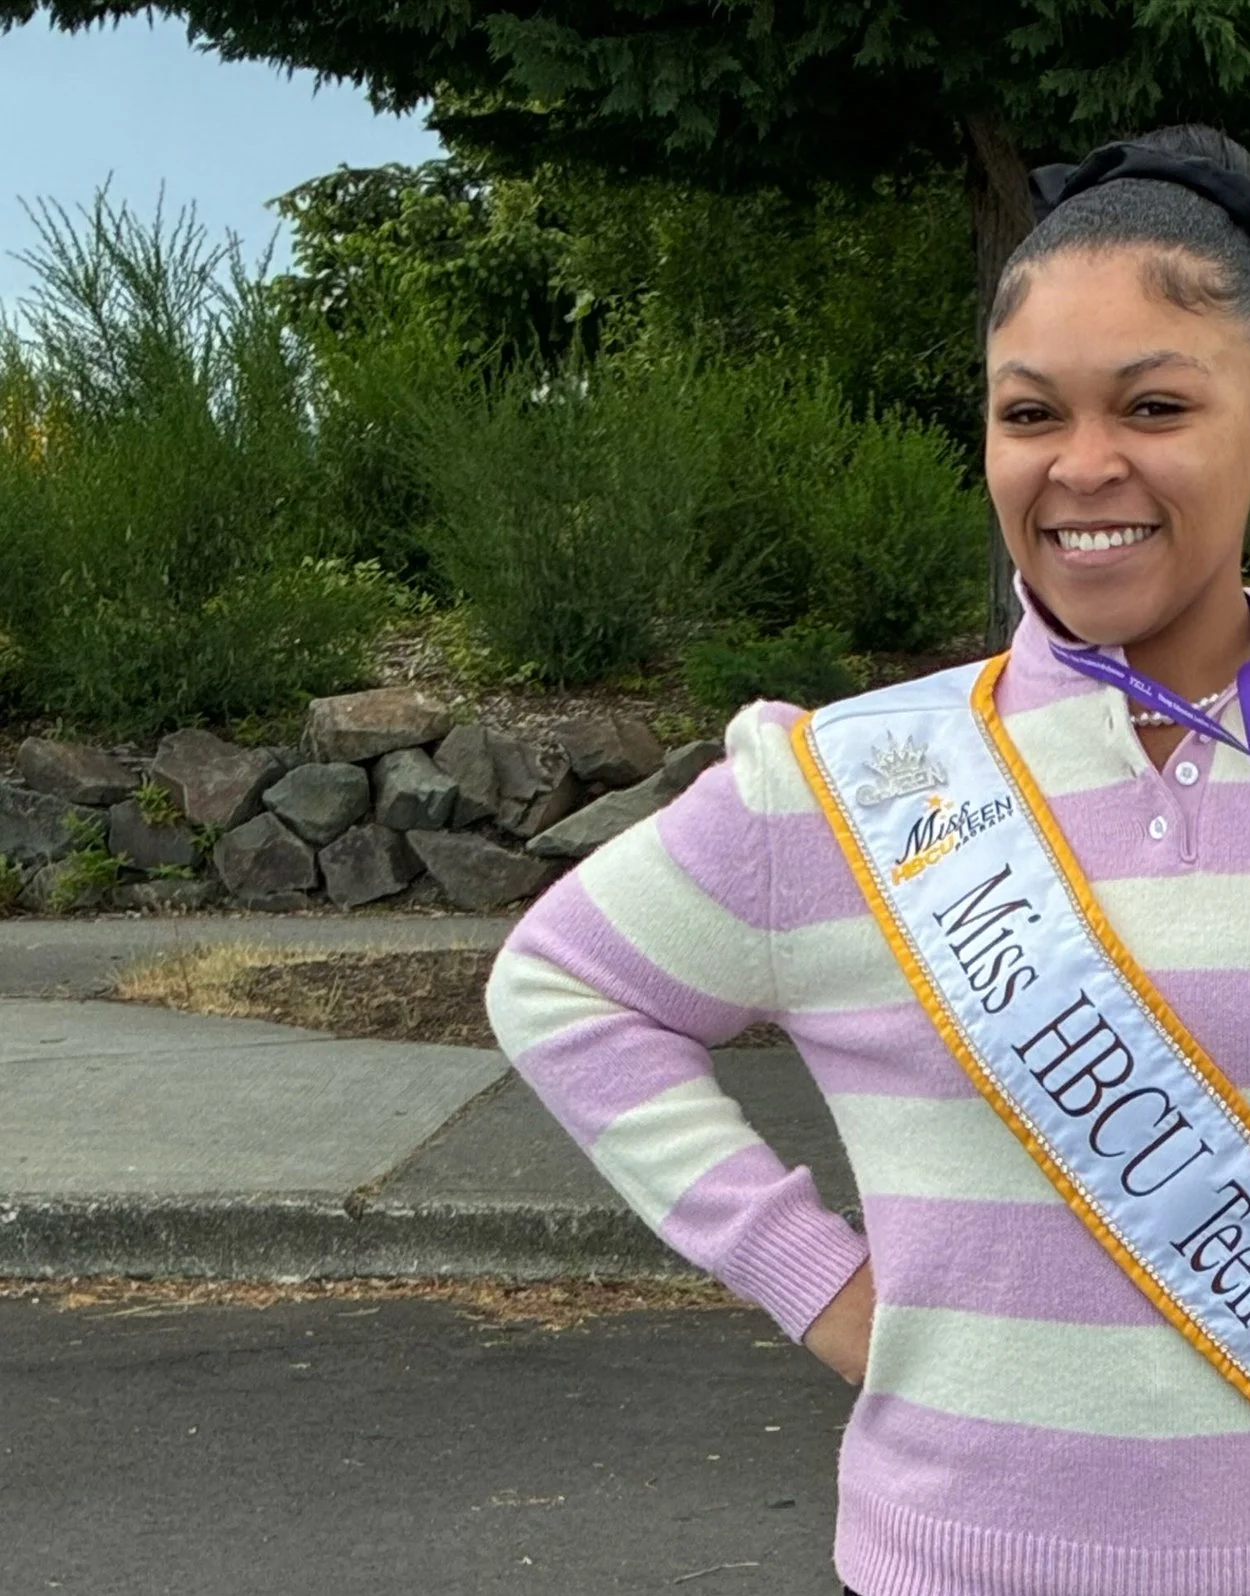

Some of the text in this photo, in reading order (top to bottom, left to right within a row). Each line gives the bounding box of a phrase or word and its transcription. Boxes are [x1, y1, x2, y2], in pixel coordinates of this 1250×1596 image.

[895, 796, 1012, 865] Miss TEEN
[932, 863, 1041, 1014] Miss
[1010, 989, 1214, 1198] HBCU
